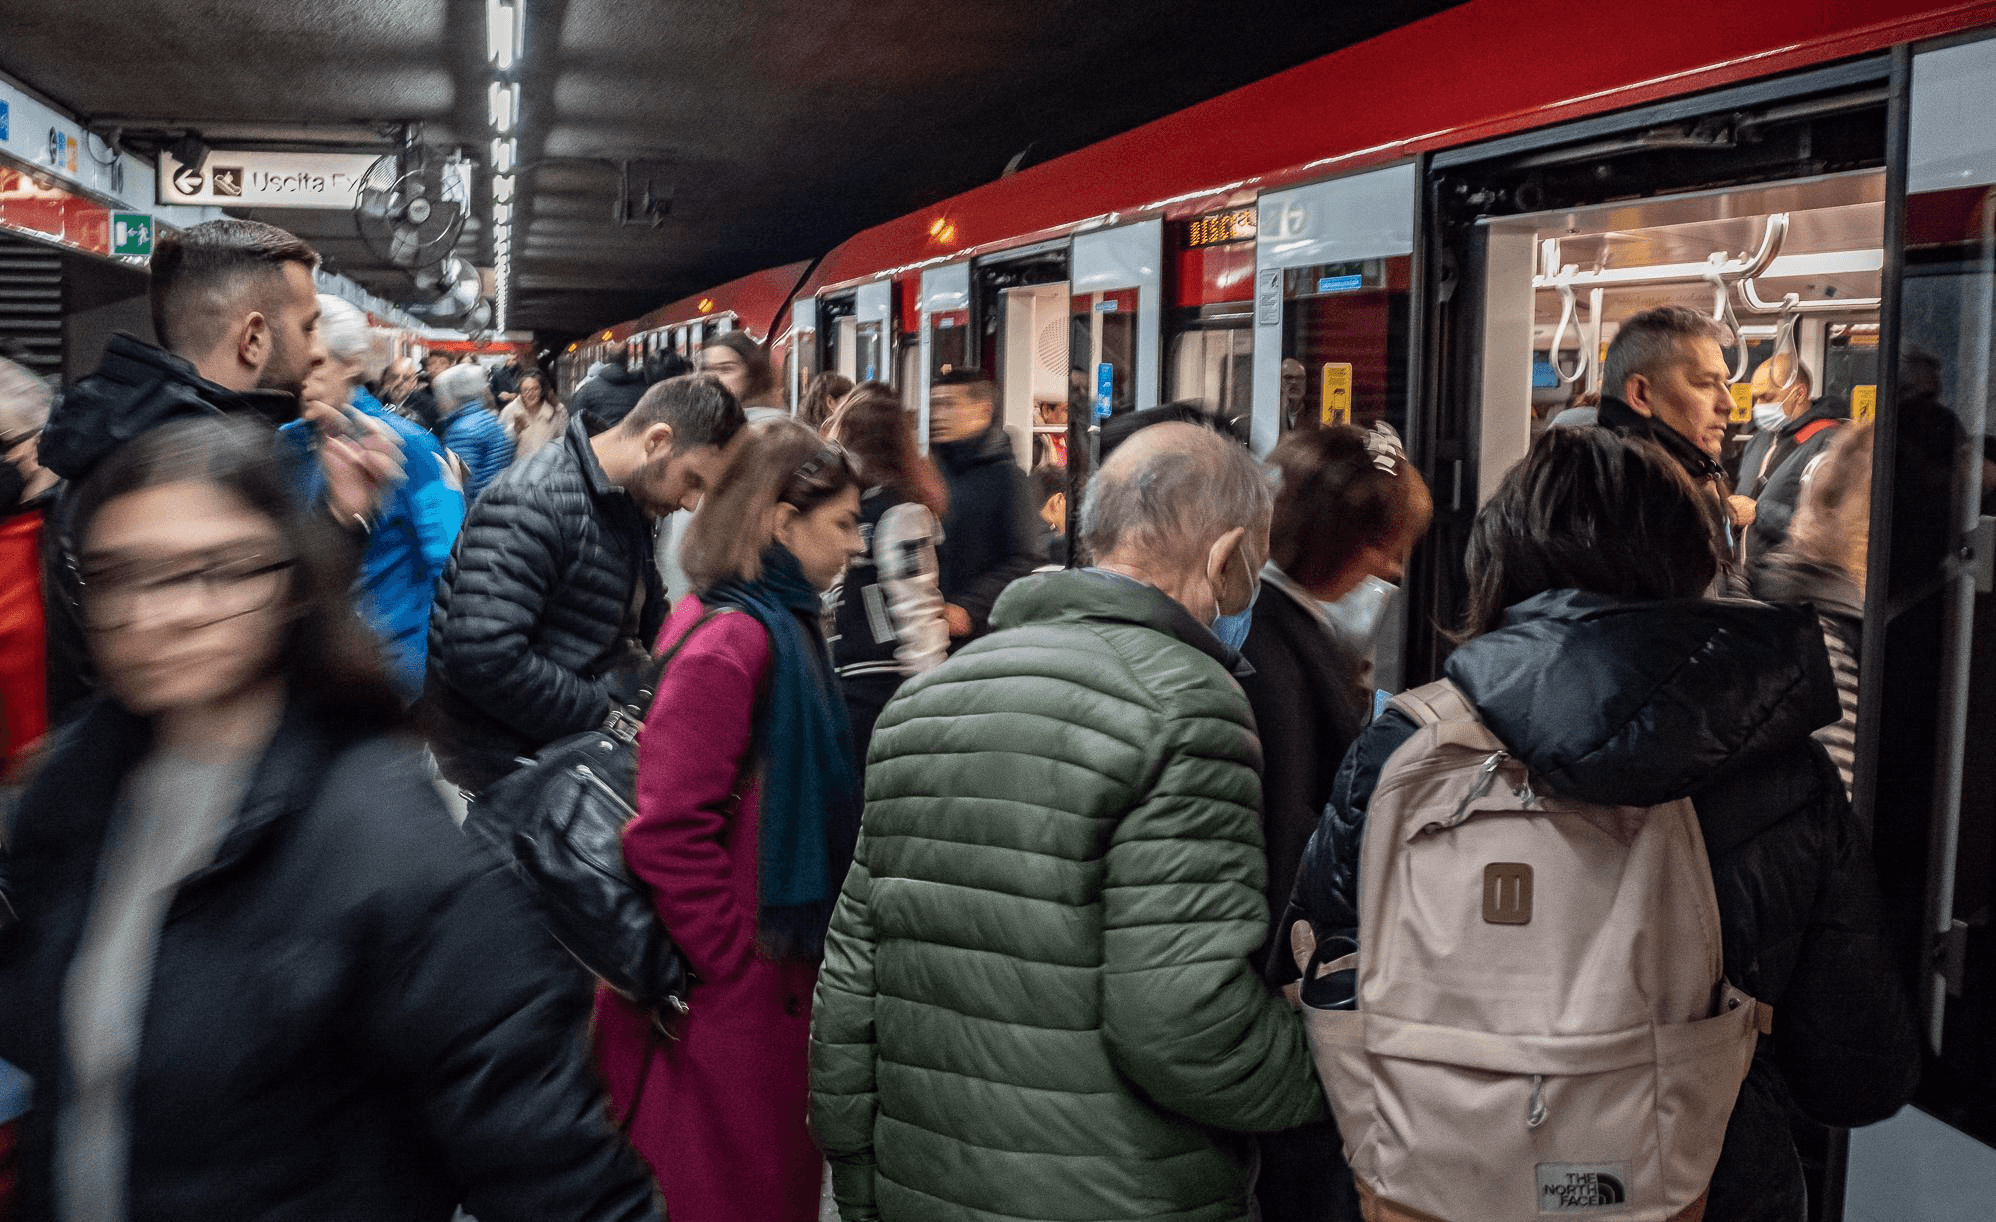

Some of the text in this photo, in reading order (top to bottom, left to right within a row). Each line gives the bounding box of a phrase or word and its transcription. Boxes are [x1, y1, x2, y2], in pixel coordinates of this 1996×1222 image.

[253, 171, 325, 193] Uscita
[1566, 1172, 1597, 1185] THE
[1543, 1184, 1598, 1196] NORTH
[1559, 1195, 1599, 1207] FACE
